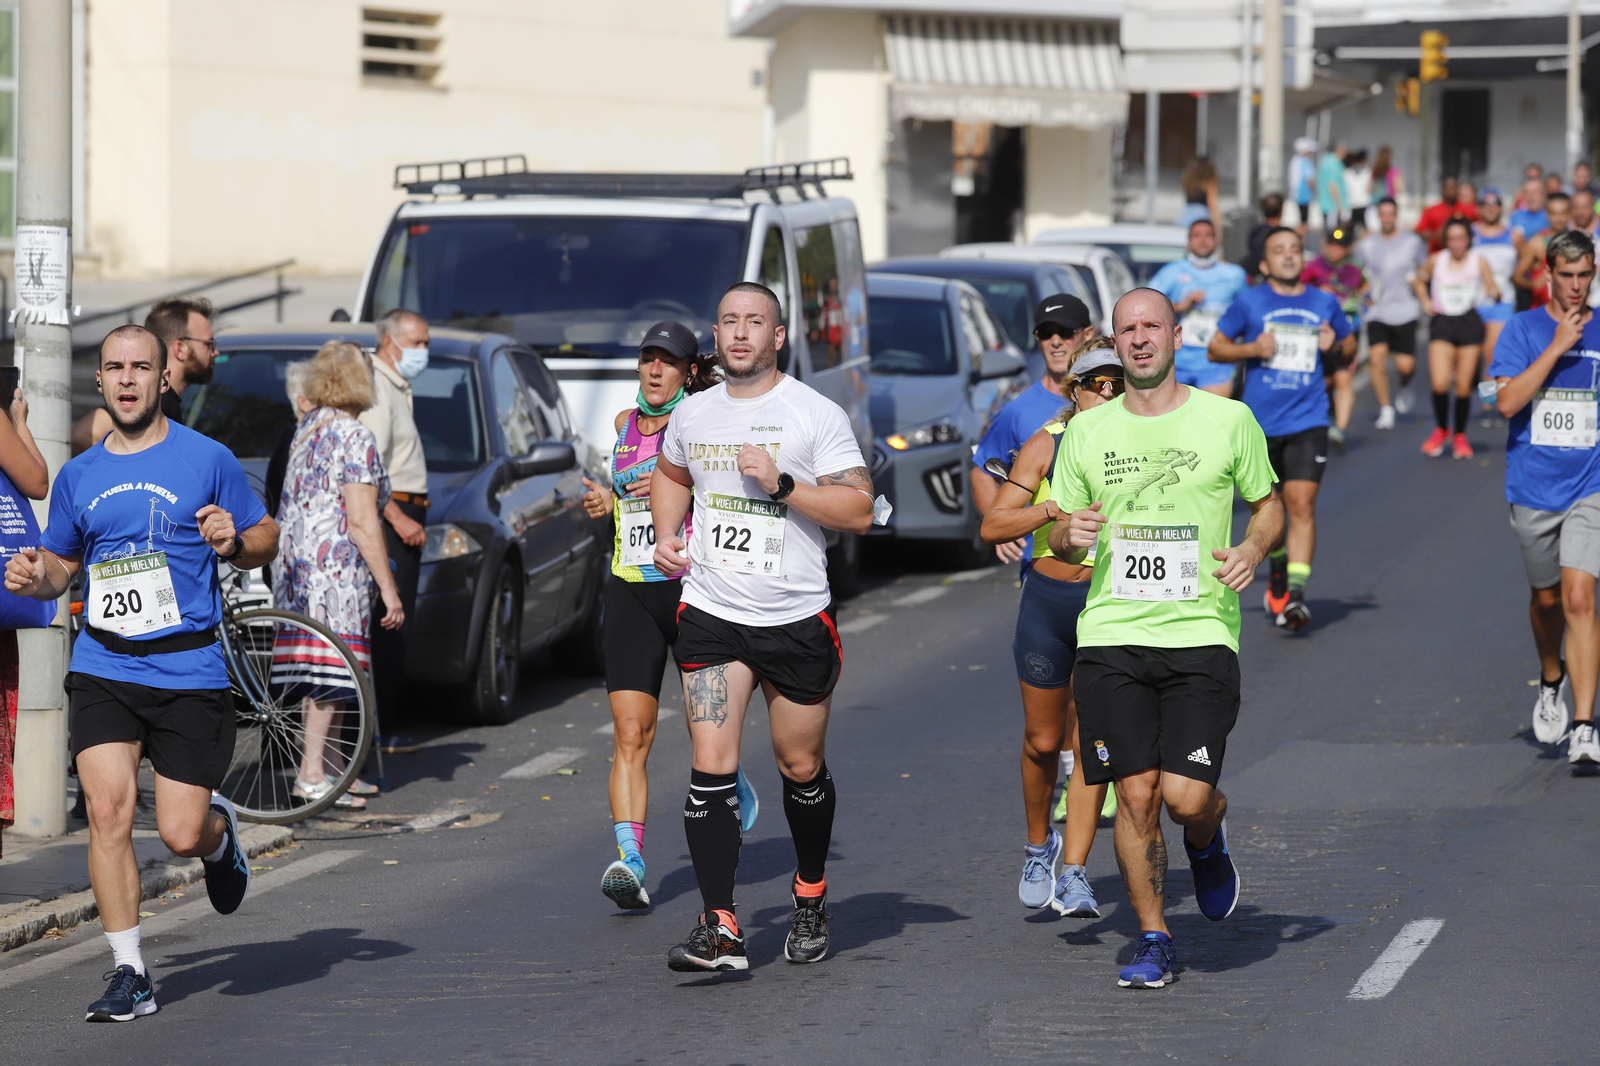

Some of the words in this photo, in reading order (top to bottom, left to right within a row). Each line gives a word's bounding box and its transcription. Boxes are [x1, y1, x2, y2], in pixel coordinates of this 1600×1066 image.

[1543, 411, 1575, 430] 608
[688, 442, 780, 463] LIONHET
[1104, 457, 1139, 467] VUELTA
[1104, 466, 1140, 476] HUELVA
[100, 482, 134, 499] VUELTA
[135, 482, 142, 490] A
[143, 482, 179, 505] HUELVA
[630, 501, 646, 512] VUELTA
[706, 496, 713, 507] 34
[716, 497, 743, 511] VUELTA
[744, 501, 750, 512] A
[751, 502, 780, 516] HUELVA
[629, 524, 656, 547] 670
[711, 524, 752, 552] 122
[1117, 529, 1124, 537] 34
[1126, 528, 1153, 539] VUELTA
[1155, 529, 1161, 539] A
[1162, 529, 1192, 539] HUELVA
[94, 568, 102, 579] 34
[101, 563, 122, 577] VUELTA
[123, 562, 130, 573] A
[130, 557, 160, 571] HUELVA
[1125, 555, 1166, 580] 208
[102, 589, 142, 618] 230
[1187, 754, 1211, 766] adidas
[791, 791, 826, 805] SPORTLAST
